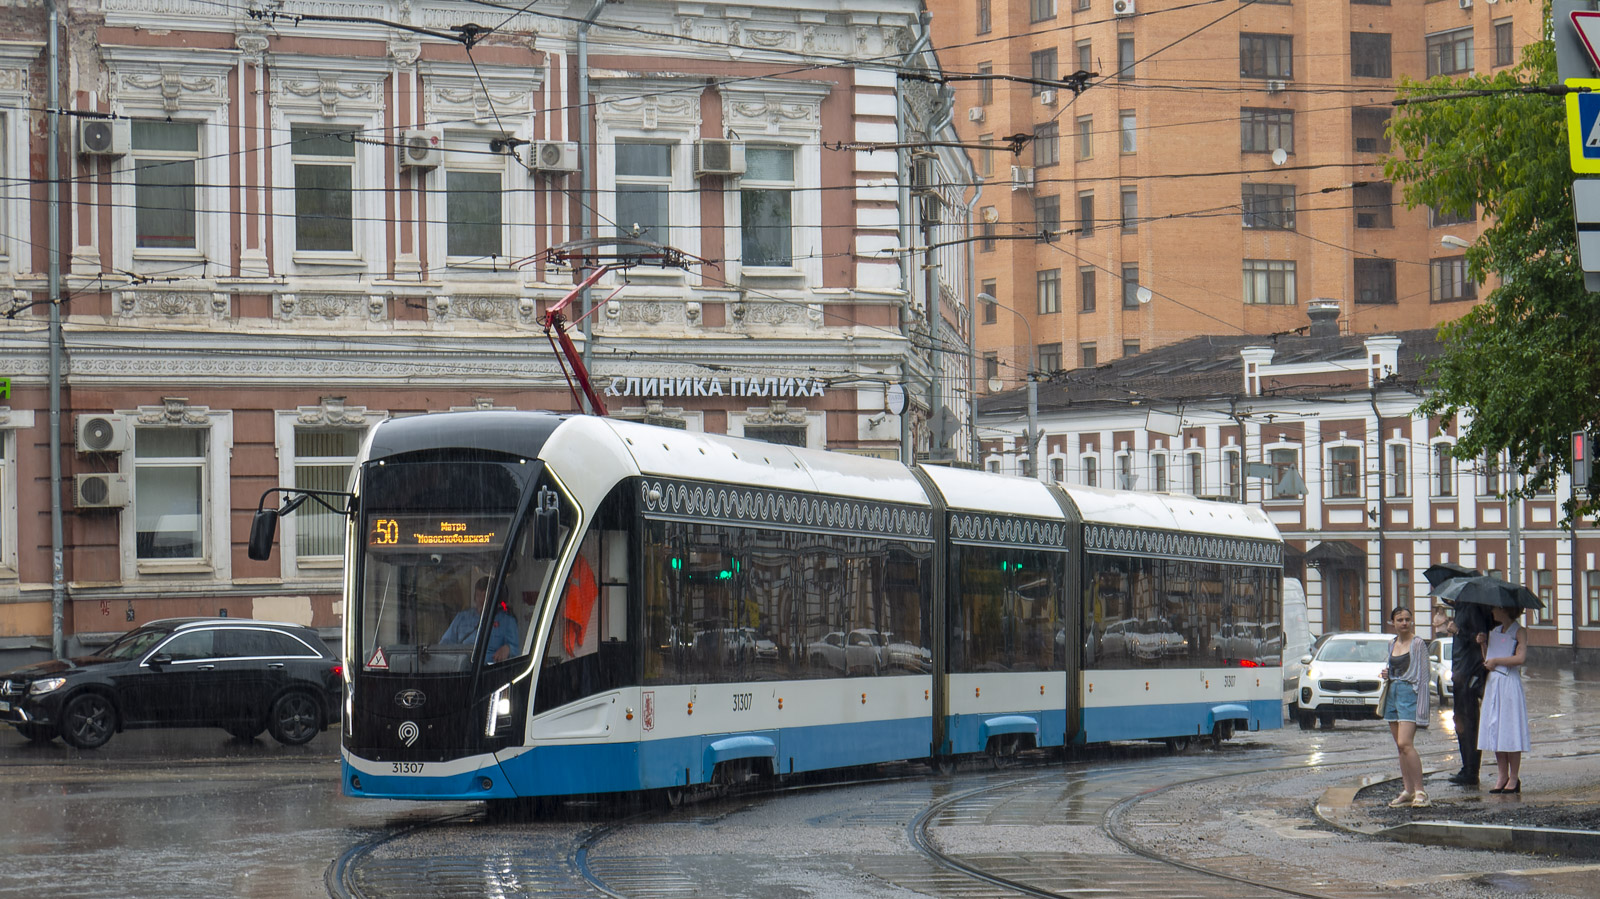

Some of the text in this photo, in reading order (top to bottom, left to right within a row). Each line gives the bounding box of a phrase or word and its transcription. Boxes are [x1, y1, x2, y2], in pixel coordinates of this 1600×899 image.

[604, 377, 825, 397] КЛИНИКА ПАЛИХА
[377, 519, 398, 544] 50
[732, 692, 753, 712] 31307
[392, 762, 425, 774] 31307
